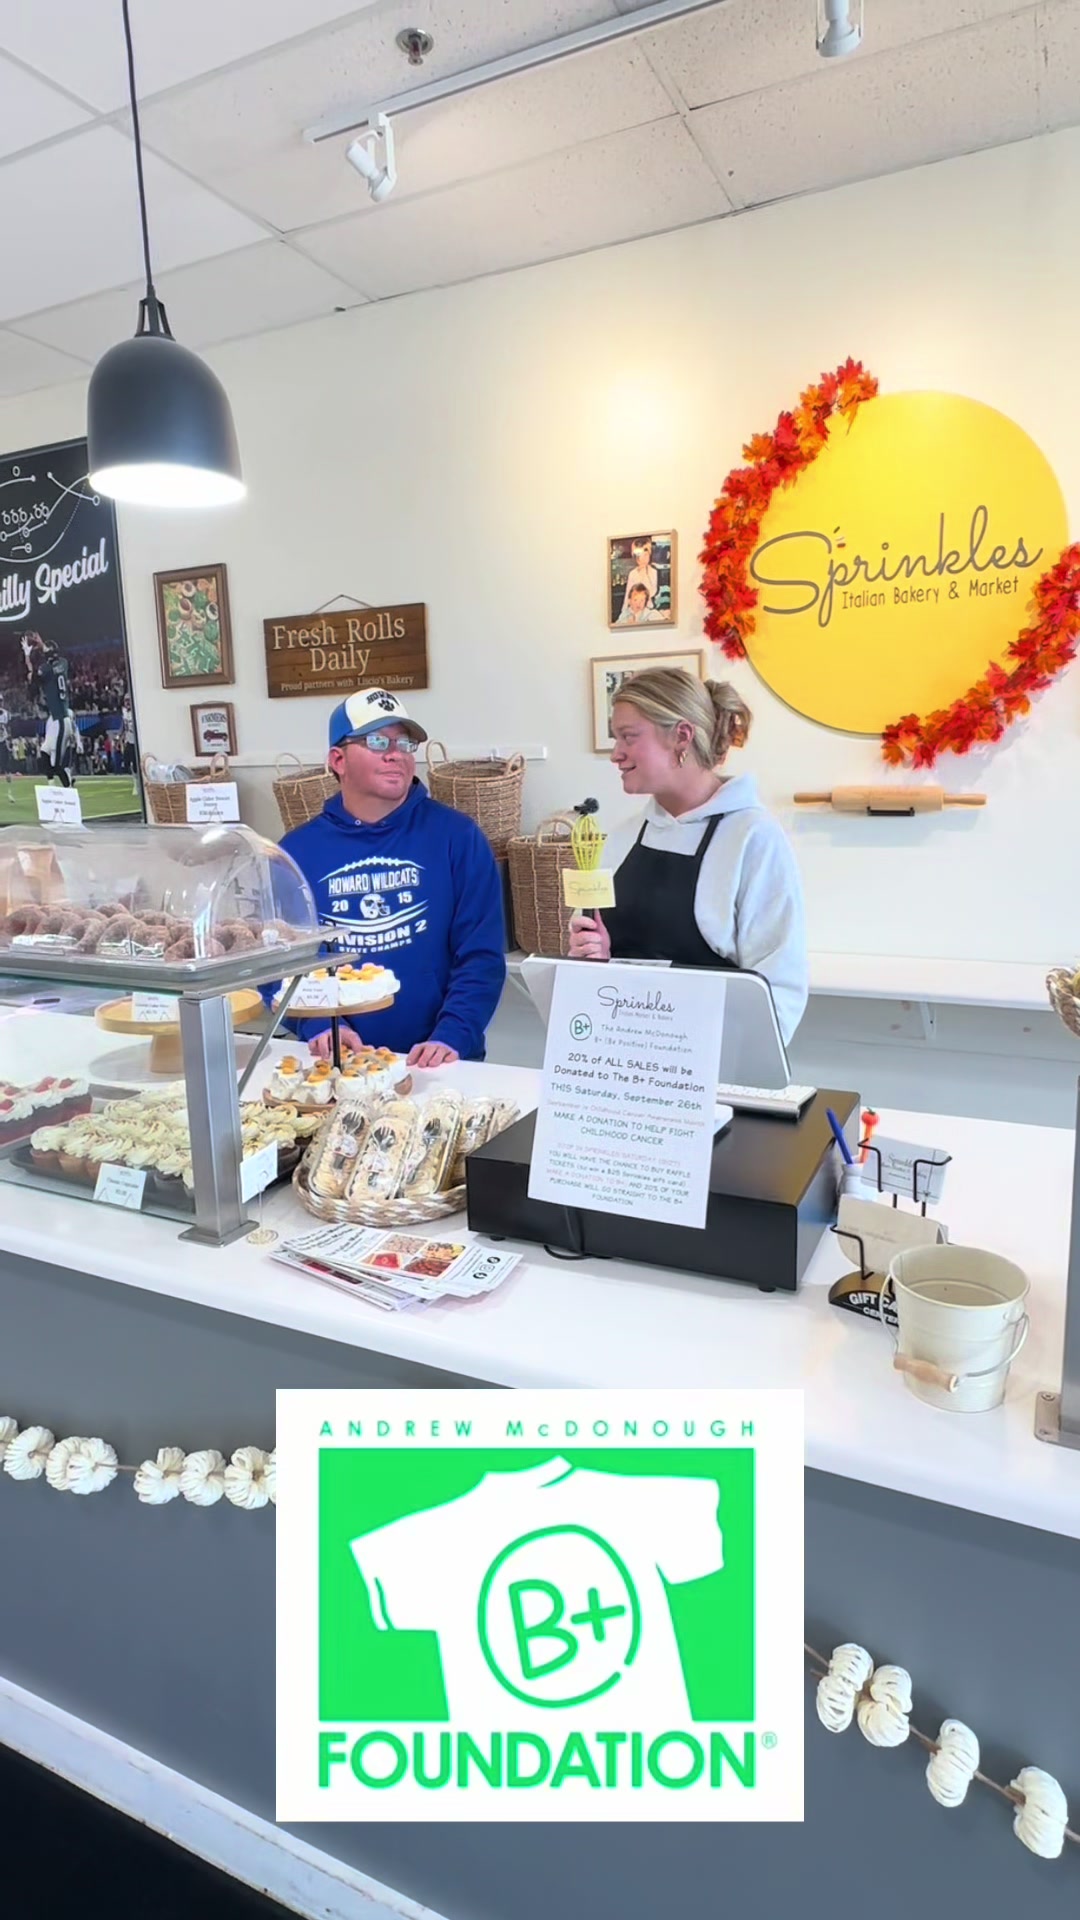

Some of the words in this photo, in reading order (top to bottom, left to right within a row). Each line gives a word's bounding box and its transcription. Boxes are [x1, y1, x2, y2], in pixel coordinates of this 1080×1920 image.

[749, 504, 1044, 628] Sprinkles
[0, 573, 31, 622] illy
[35, 537, 109, 605] Special
[841, 590, 886, 610] Italian
[893, 585, 940, 606] Bakery
[948, 581, 960, 600] &
[968, 576, 1019, 598] Market
[272, 619, 337, 650] Fresh
[345, 612, 406, 644] Rolls
[309, 643, 371, 676] Daily
[57, 674, 66, 700] 9
[281, 681, 303, 692] Proud
[303, 678, 335, 692] partners
[336, 678, 354, 688] with
[386, 674, 415, 686] Bakery
[328, 874, 371, 897] HOWARD
[370, 867, 420, 893] WILDCATS
[331, 899, 349, 913] 20
[397, 891, 413, 904] 15
[414, 919, 427, 934] 2
[339, 946, 368, 954] STATE
[370, 938, 412, 953] CHAMPS
[597, 985, 676, 1019] Sprinkles
[574, 1020, 590, 1035] B+
[601, 1024, 614, 1032] The
[649, 1042, 693, 1054] Foundation
[567, 1052, 588, 1064] 20%
[591, 1055, 602, 1065] of
[604, 1057, 624, 1068] ALL
[627, 1059, 659, 1072] SALES
[662, 1065, 677, 1074] will
[680, 1066, 693, 1076] be
[553, 1064, 595, 1079] Donated
[598, 1071, 609, 1080] to
[612, 1071, 629, 1083] The
[632, 1074, 646, 1085] B+
[648, 1076, 706, 1093] Foundation
[550, 1082, 572, 1093] THIS
[623, 1092, 674, 1107] September
[677, 1099, 703, 1111] 26th
[553, 1110, 576, 1121] MAKE
[578, 1114, 584, 1122] A
[586, 1115, 629, 1129] DONATION
[631, 1121, 643, 1131] TO
[644, 1124, 667, 1135] HELP
[669, 1127, 695, 1138] FIGHT
[580, 1126, 629, 1141] CHILDHOOD
[630, 1133, 665, 1146] CANCER
[666, 1168, 691, 1179] RAFFLE
[591, 1193, 634, 1207] FOUNDATION
[848, 1291, 878, 1305] GIFT
[881, 1296, 898, 1312] CA
